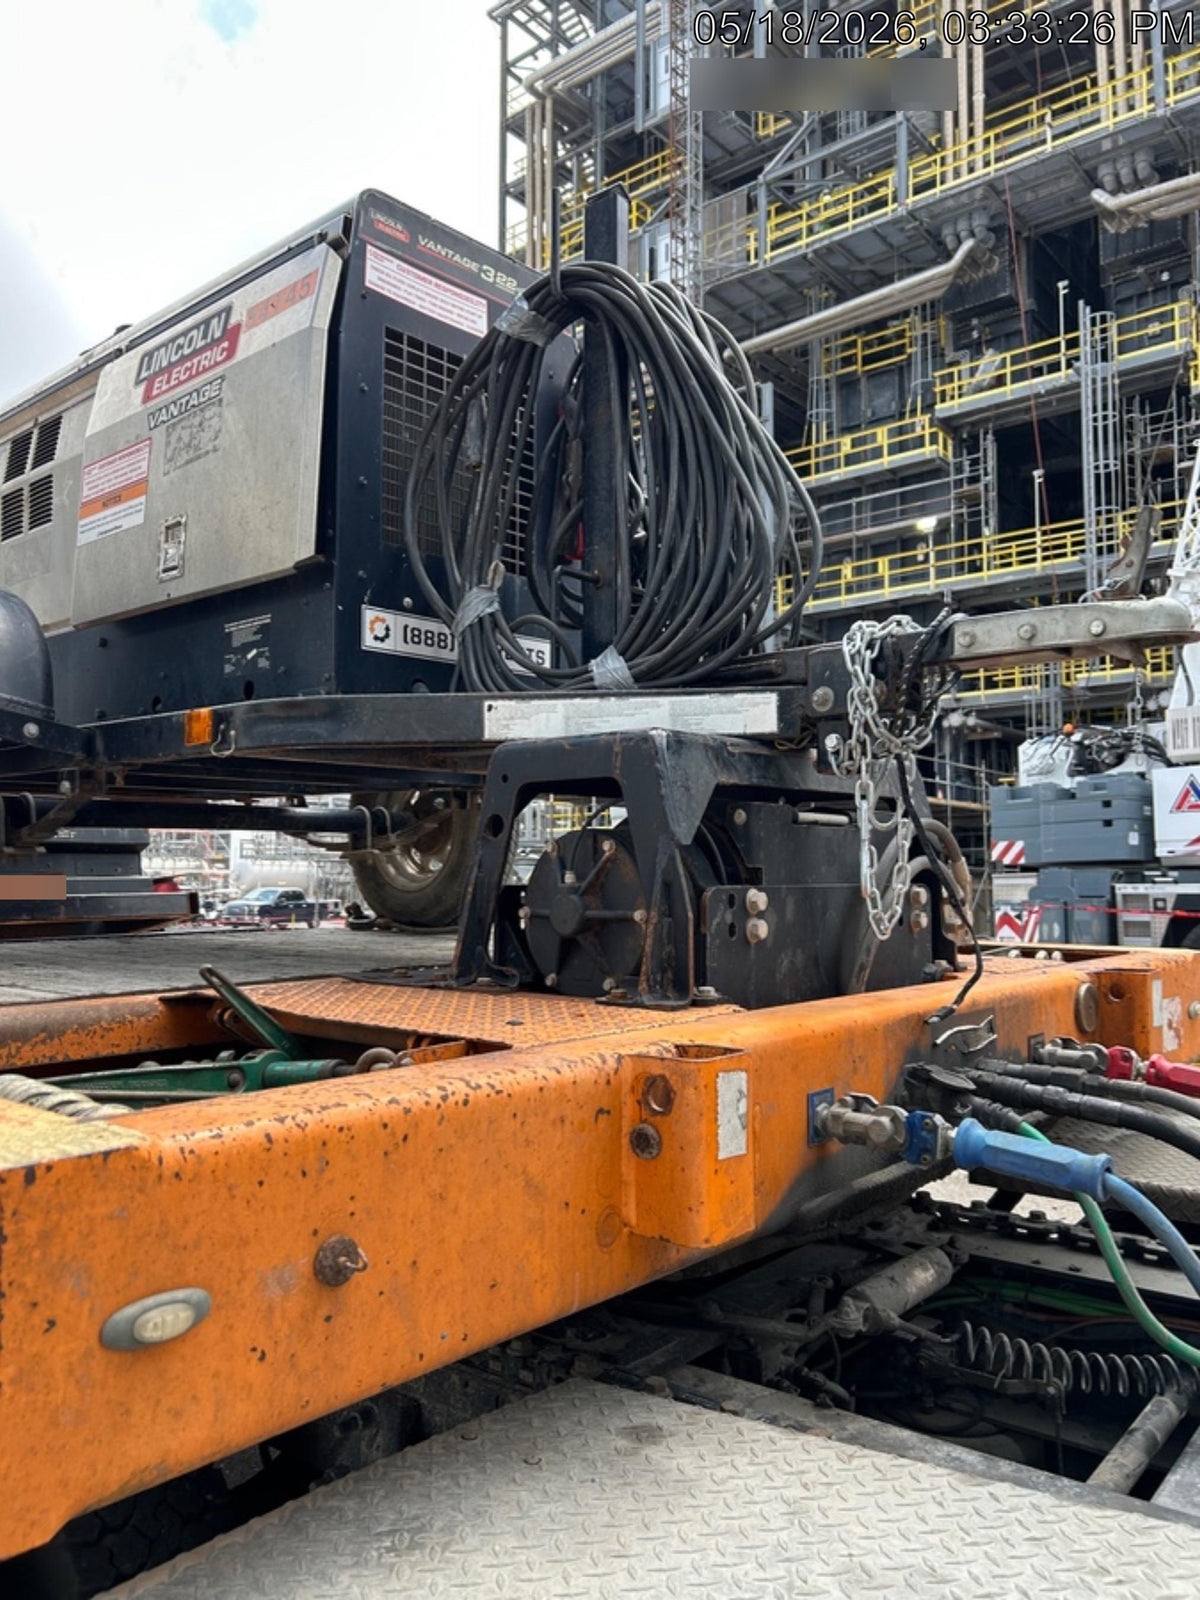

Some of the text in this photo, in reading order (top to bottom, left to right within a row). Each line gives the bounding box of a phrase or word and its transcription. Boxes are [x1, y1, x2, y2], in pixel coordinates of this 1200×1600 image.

[417, 234, 480, 273] VANTAGE
[480, 264, 518, 289] 322
[139, 312, 227, 380] LINCOLN
[152, 341, 230, 396] ELECTRIC
[148, 378, 224, 430] VANTAGE
[403, 623, 456, 652] (888)
